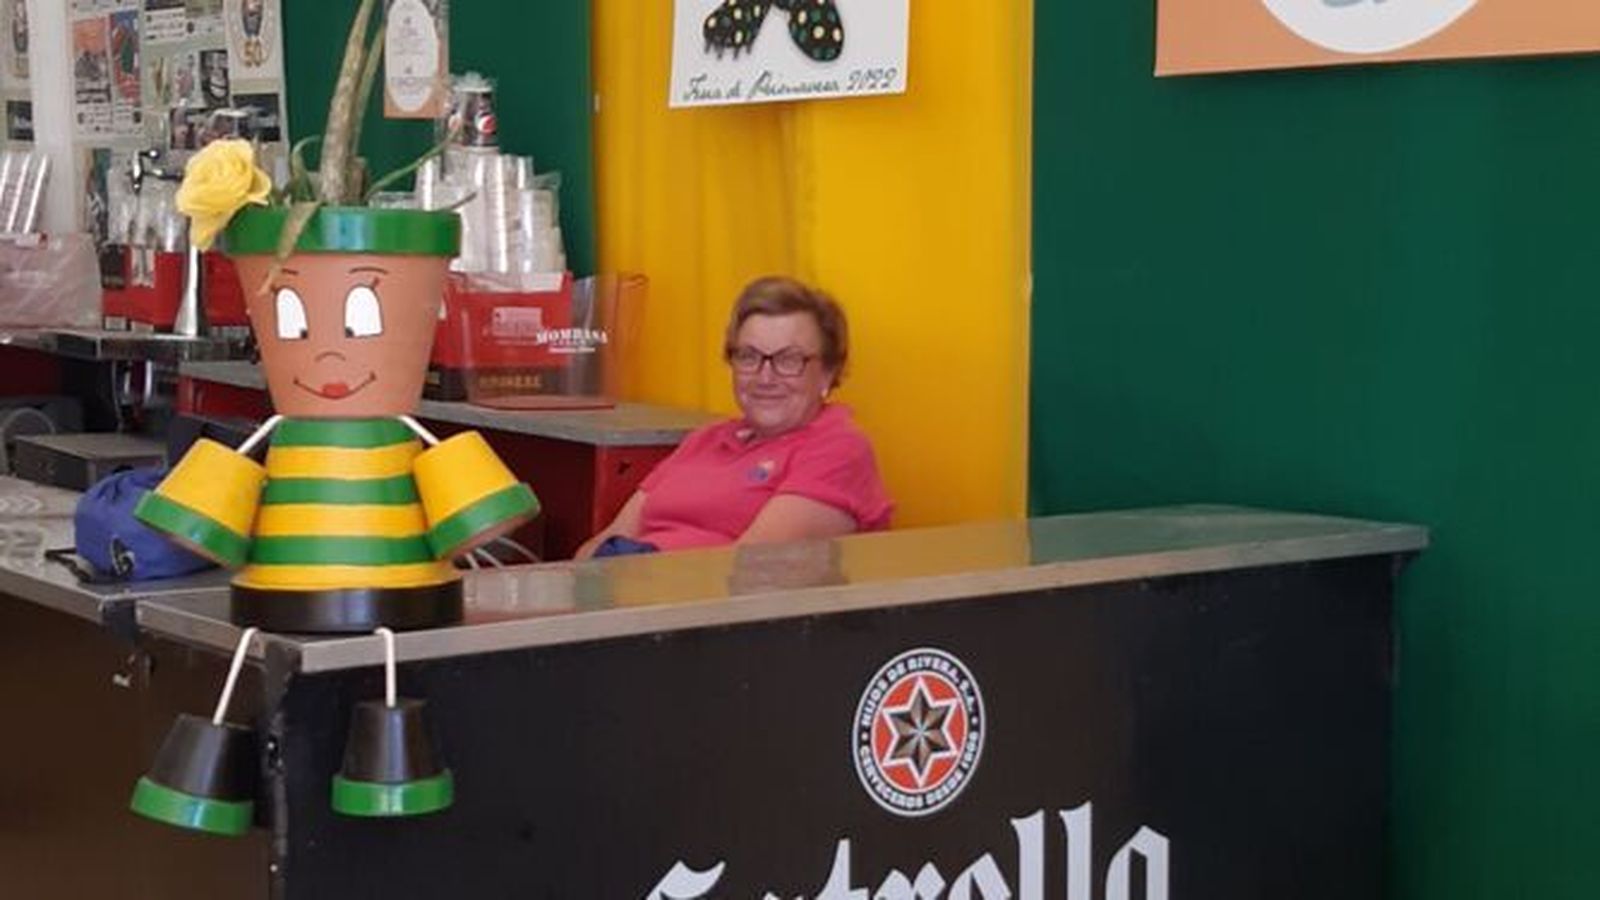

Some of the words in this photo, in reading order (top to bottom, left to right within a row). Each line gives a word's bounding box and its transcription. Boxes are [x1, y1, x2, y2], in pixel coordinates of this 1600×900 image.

[846, 67, 898, 91] 2022
[861, 679, 888, 727] HIJOS
[887, 661, 908, 682] DE
[643, 801, 1171, 900] trella
